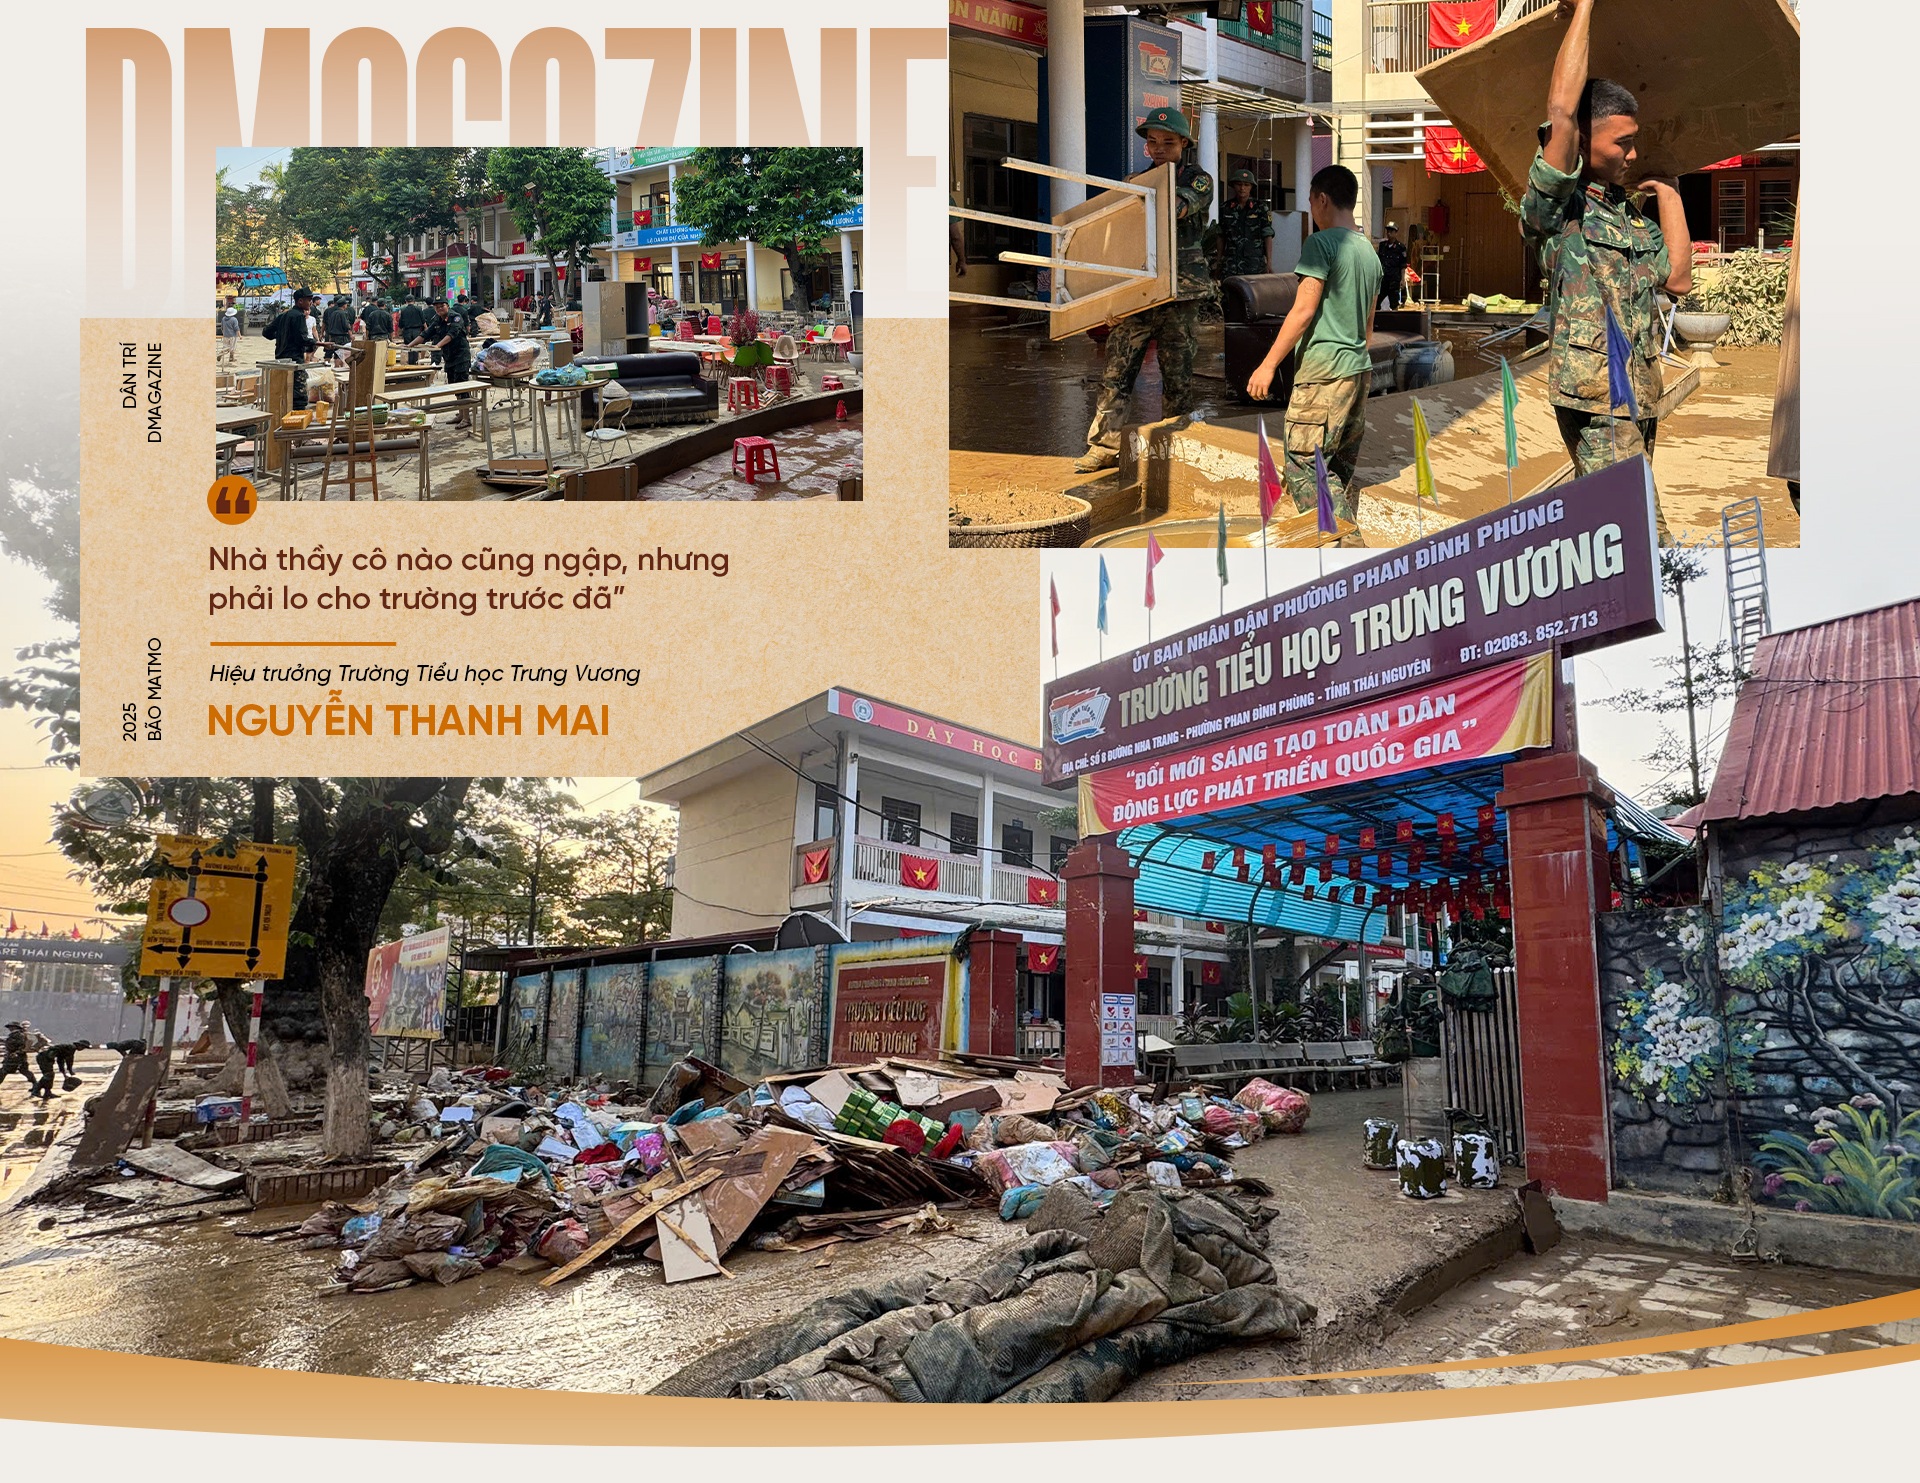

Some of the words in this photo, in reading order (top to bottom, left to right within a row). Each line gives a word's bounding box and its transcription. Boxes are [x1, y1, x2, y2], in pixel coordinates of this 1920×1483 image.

[975, 5, 1024, 33] NĂM!
[1132, 651, 1149, 673] ỦY
[1154, 640, 1183, 665] BAN
[1187, 623, 1230, 652] NHÂN
[1234, 608, 1268, 636] DÂN
[1273, 579, 1348, 622] PHƯỜNG
[1353, 555, 1410, 593] PHAN
[1415, 532, 1470, 571] ĐÌNH
[1477, 499, 1564, 548] PHÙNG
[1118, 665, 1210, 729] TRƯỜNG
[1216, 630, 1272, 698] TIỂU
[1281, 620, 1342, 680] HỌC
[1350, 577, 1466, 656] TRƯNG
[1476, 523, 1626, 616] VƯƠNG
[1460, 644, 1481, 664] ĐT:
[1484, 630, 1532, 656] 02083.
[907, 718, 955, 744] DẠY
[972, 739, 1019, 765] HỌC
[1062, 759, 1074, 776] ĐỊA
[1090, 745, 1101, 766] SỐ
[1101, 752, 1107, 763] 8
[1107, 743, 1133, 760] ĐƯỜNG
[1134, 739, 1151, 752] NHA
[1152, 732, 1179, 749] TRANG
[1186, 720, 1222, 741] PHƯỜNG
[1224, 711, 1250, 730] PHAN
[1252, 702, 1277, 721] ĐÌNH
[1279, 691, 1314, 715] PHÙNG
[1324, 681, 1350, 701] TỈNH
[1352, 672, 1379, 693] THÁI
[1382, 658, 1431, 686] NGUYÊN
[1126, 762, 1164, 790] “ĐỔI
[1169, 756, 1205, 783] MỚI
[1211, 741, 1268, 773] SÁNG
[1274, 729, 1317, 759] TẠO
[1323, 710, 1390, 745] TOÀN
[1397, 693, 1456, 728] DÂN
[1112, 797, 1159, 824] ĐỘNG
[1164, 787, 1199, 814] LỰC
[1204, 775, 1257, 804] PHÁT
[1262, 754, 1328, 791] TRIỂN
[1335, 737, 1405, 778] QUỐC
[22, 948, 49, 958] THÁI
[52, 950, 104, 960] NGUYÊN
[848, 1030, 880, 1053] TRƯNG
[882, 1030, 918, 1054] VƯƠNG
